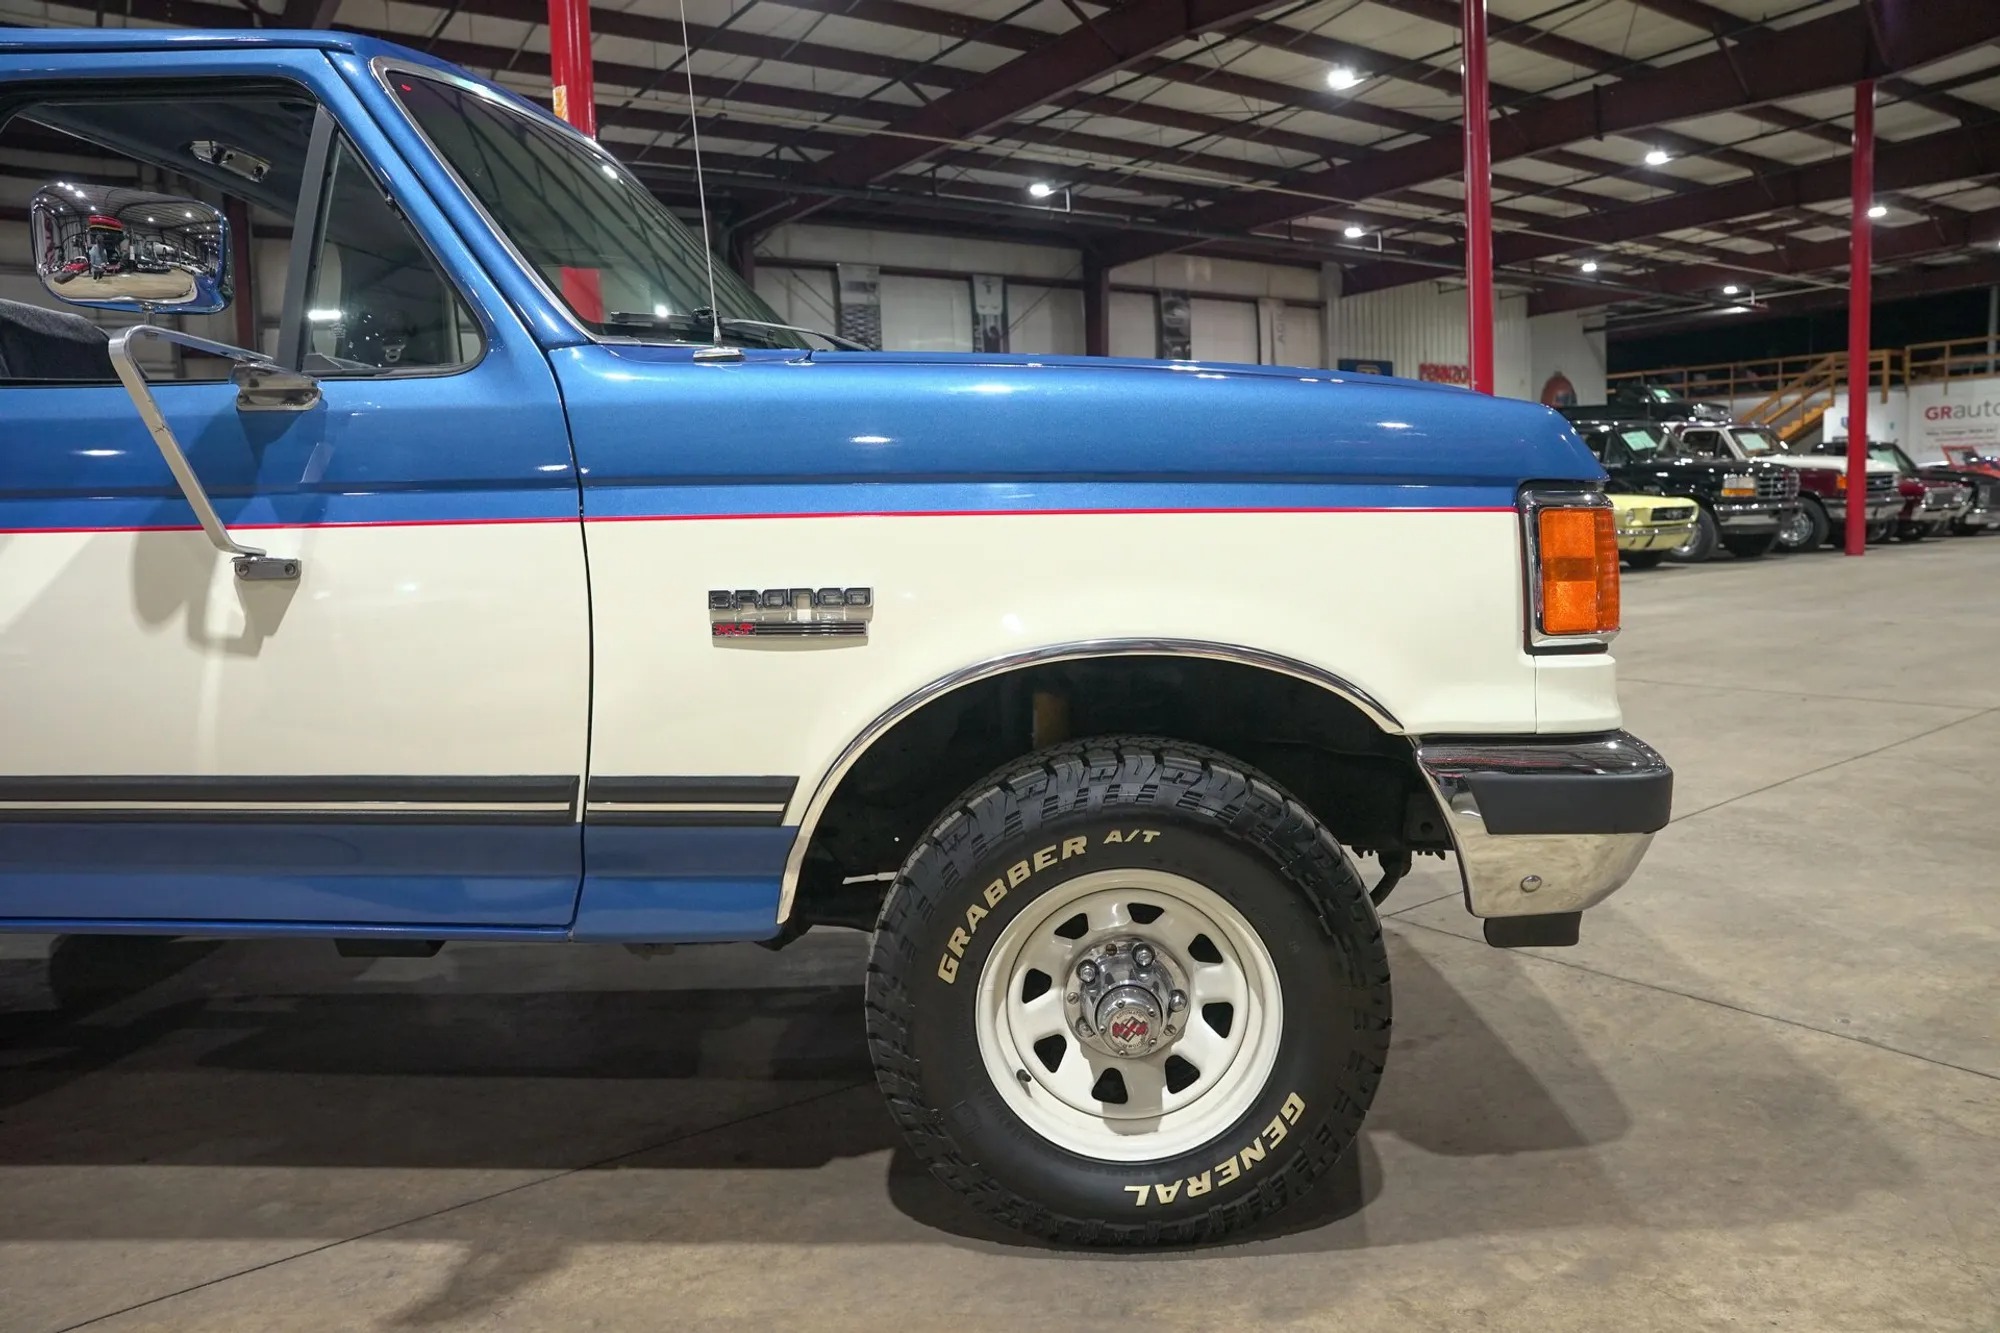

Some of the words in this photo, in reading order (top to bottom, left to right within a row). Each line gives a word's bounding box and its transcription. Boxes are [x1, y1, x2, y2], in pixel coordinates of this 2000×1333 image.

[708, 587, 873, 610] BRONCO
[937, 835, 1088, 985] GRABBER
[1103, 829, 1161, 844] A/T
[1123, 1091, 1306, 1207] GENERAL
